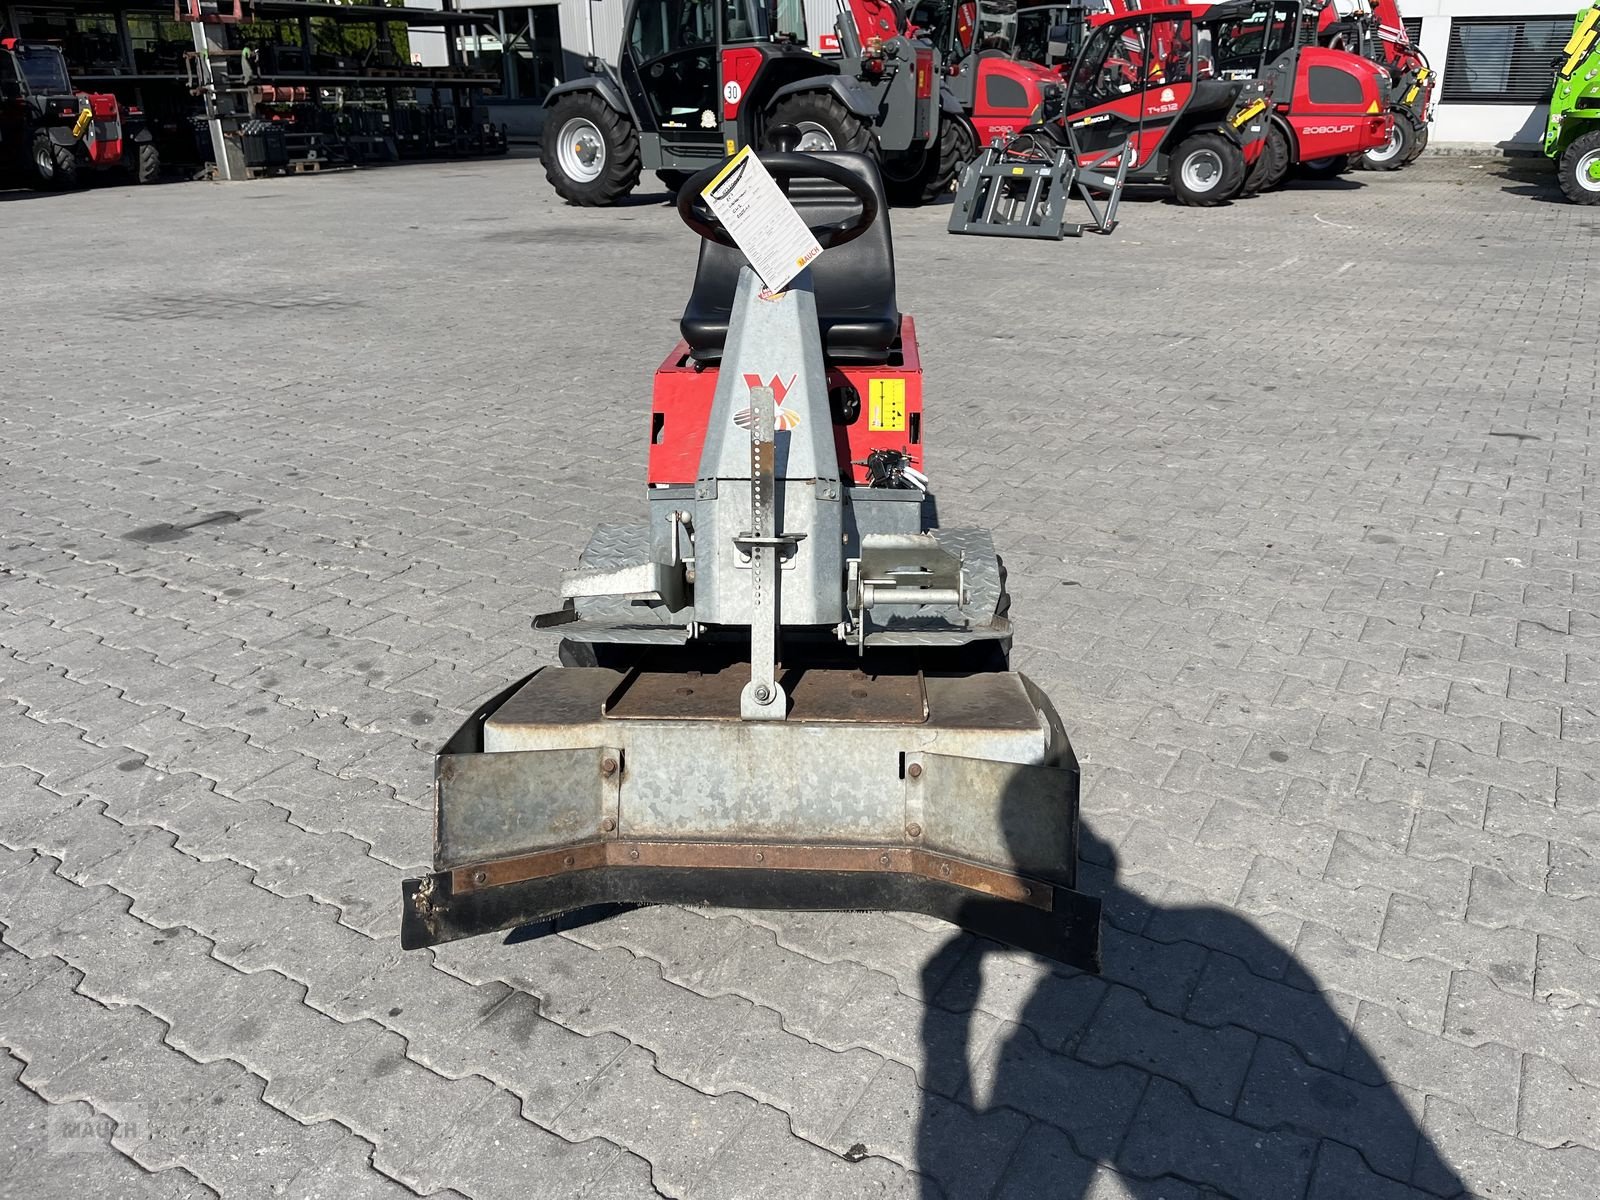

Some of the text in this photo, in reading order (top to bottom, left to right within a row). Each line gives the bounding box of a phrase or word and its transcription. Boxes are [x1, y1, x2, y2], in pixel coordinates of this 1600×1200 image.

[727, 86, 738, 99] 30
[1302, 125, 1355, 135] 2080LPT
[798, 246, 820, 267] MAUCH
